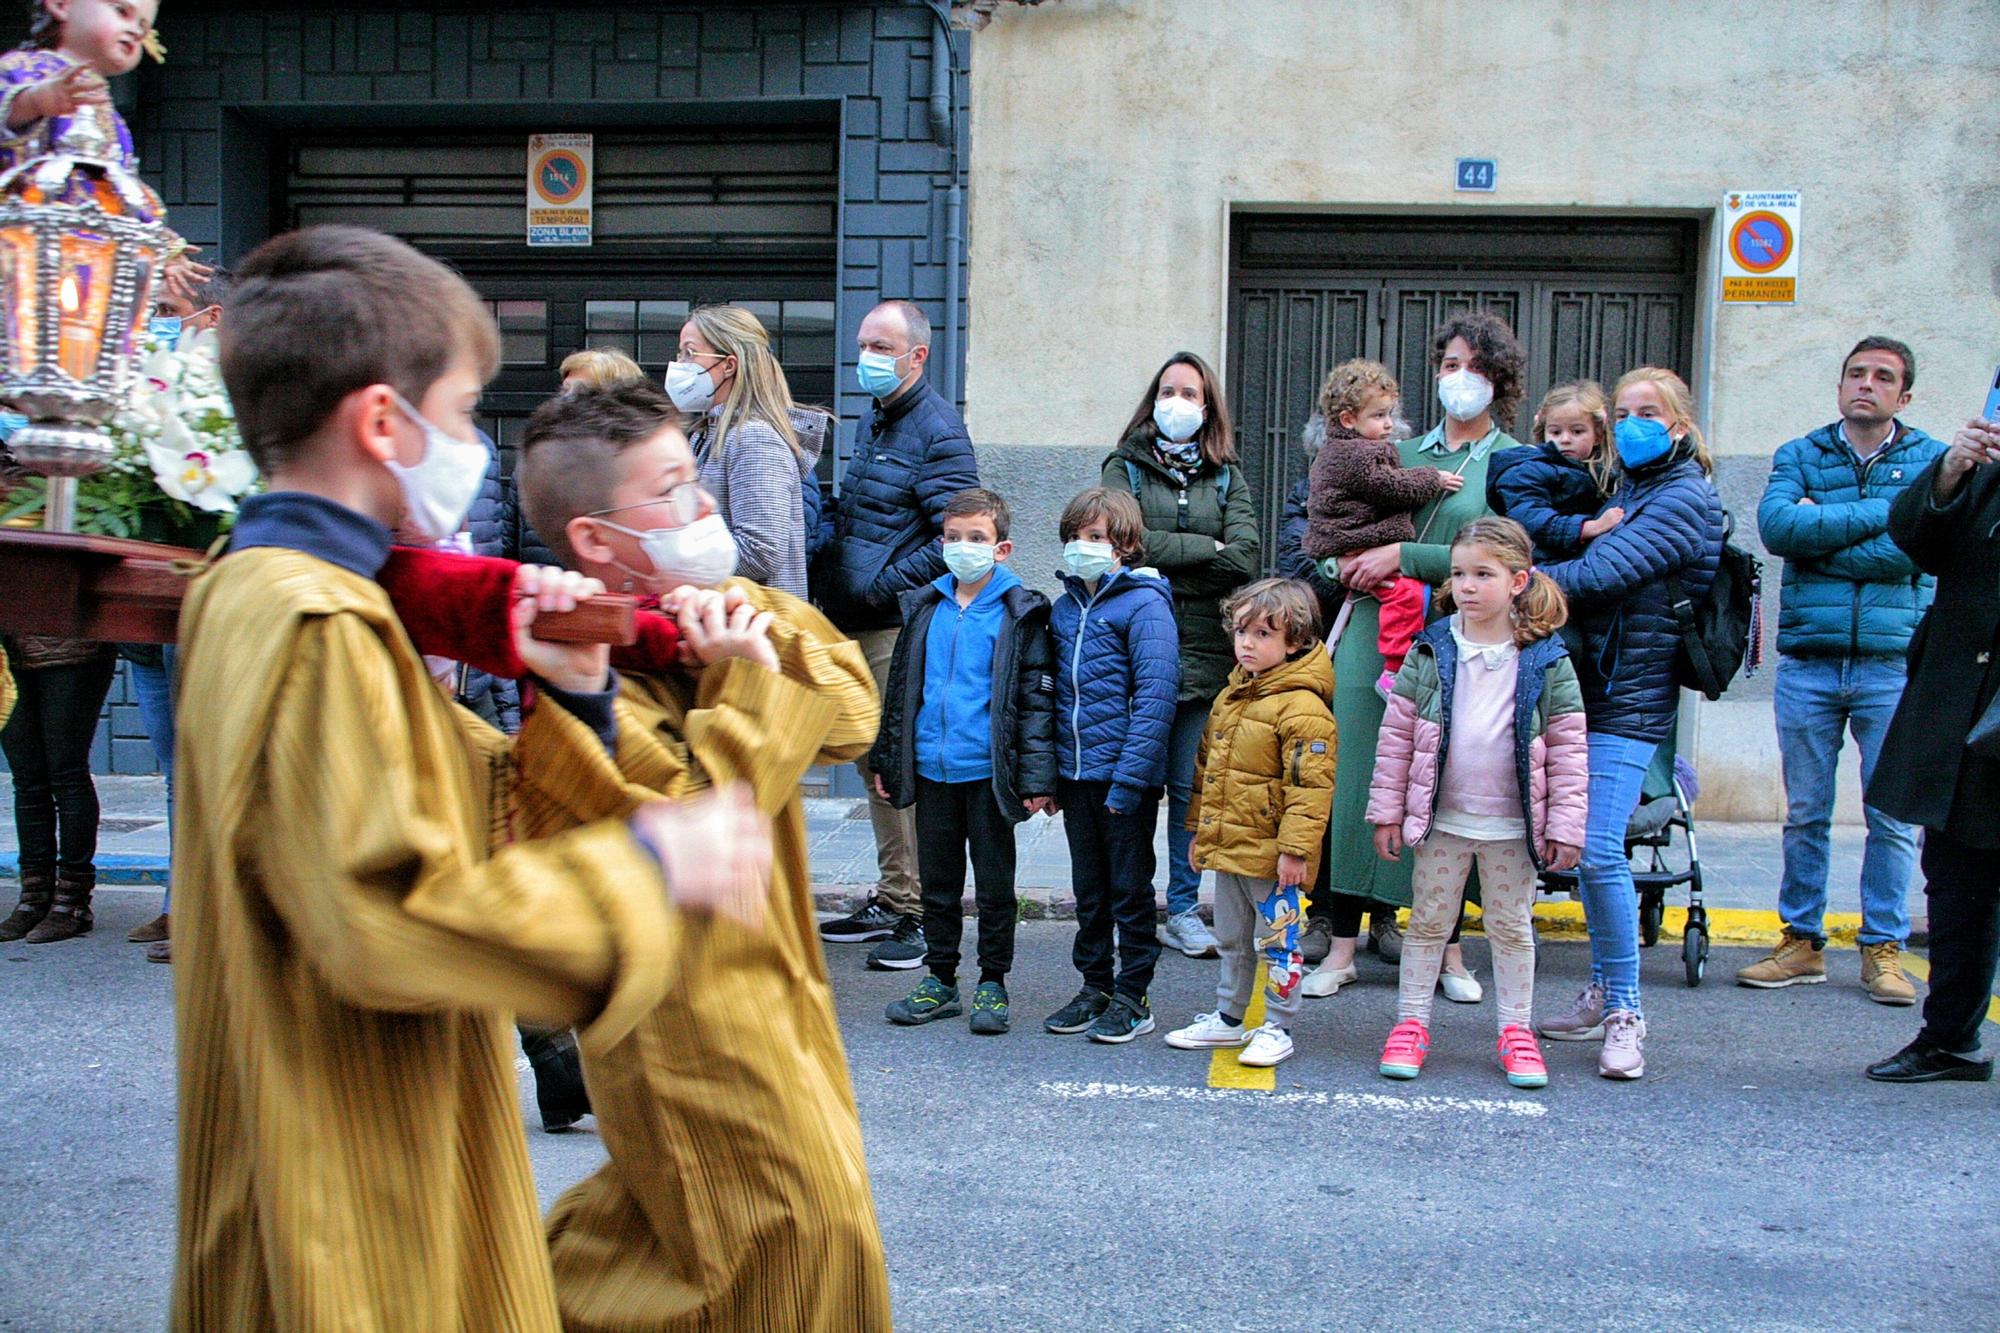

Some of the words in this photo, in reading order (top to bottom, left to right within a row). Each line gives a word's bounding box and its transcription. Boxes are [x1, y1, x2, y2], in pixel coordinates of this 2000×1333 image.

[1464, 165, 1488, 185] 44
[536, 216, 584, 224] TEMPORAL
[531, 228, 557, 236] ZONA
[559, 228, 588, 236] BLAVA
[1724, 290, 1793, 298] PERMANENT
